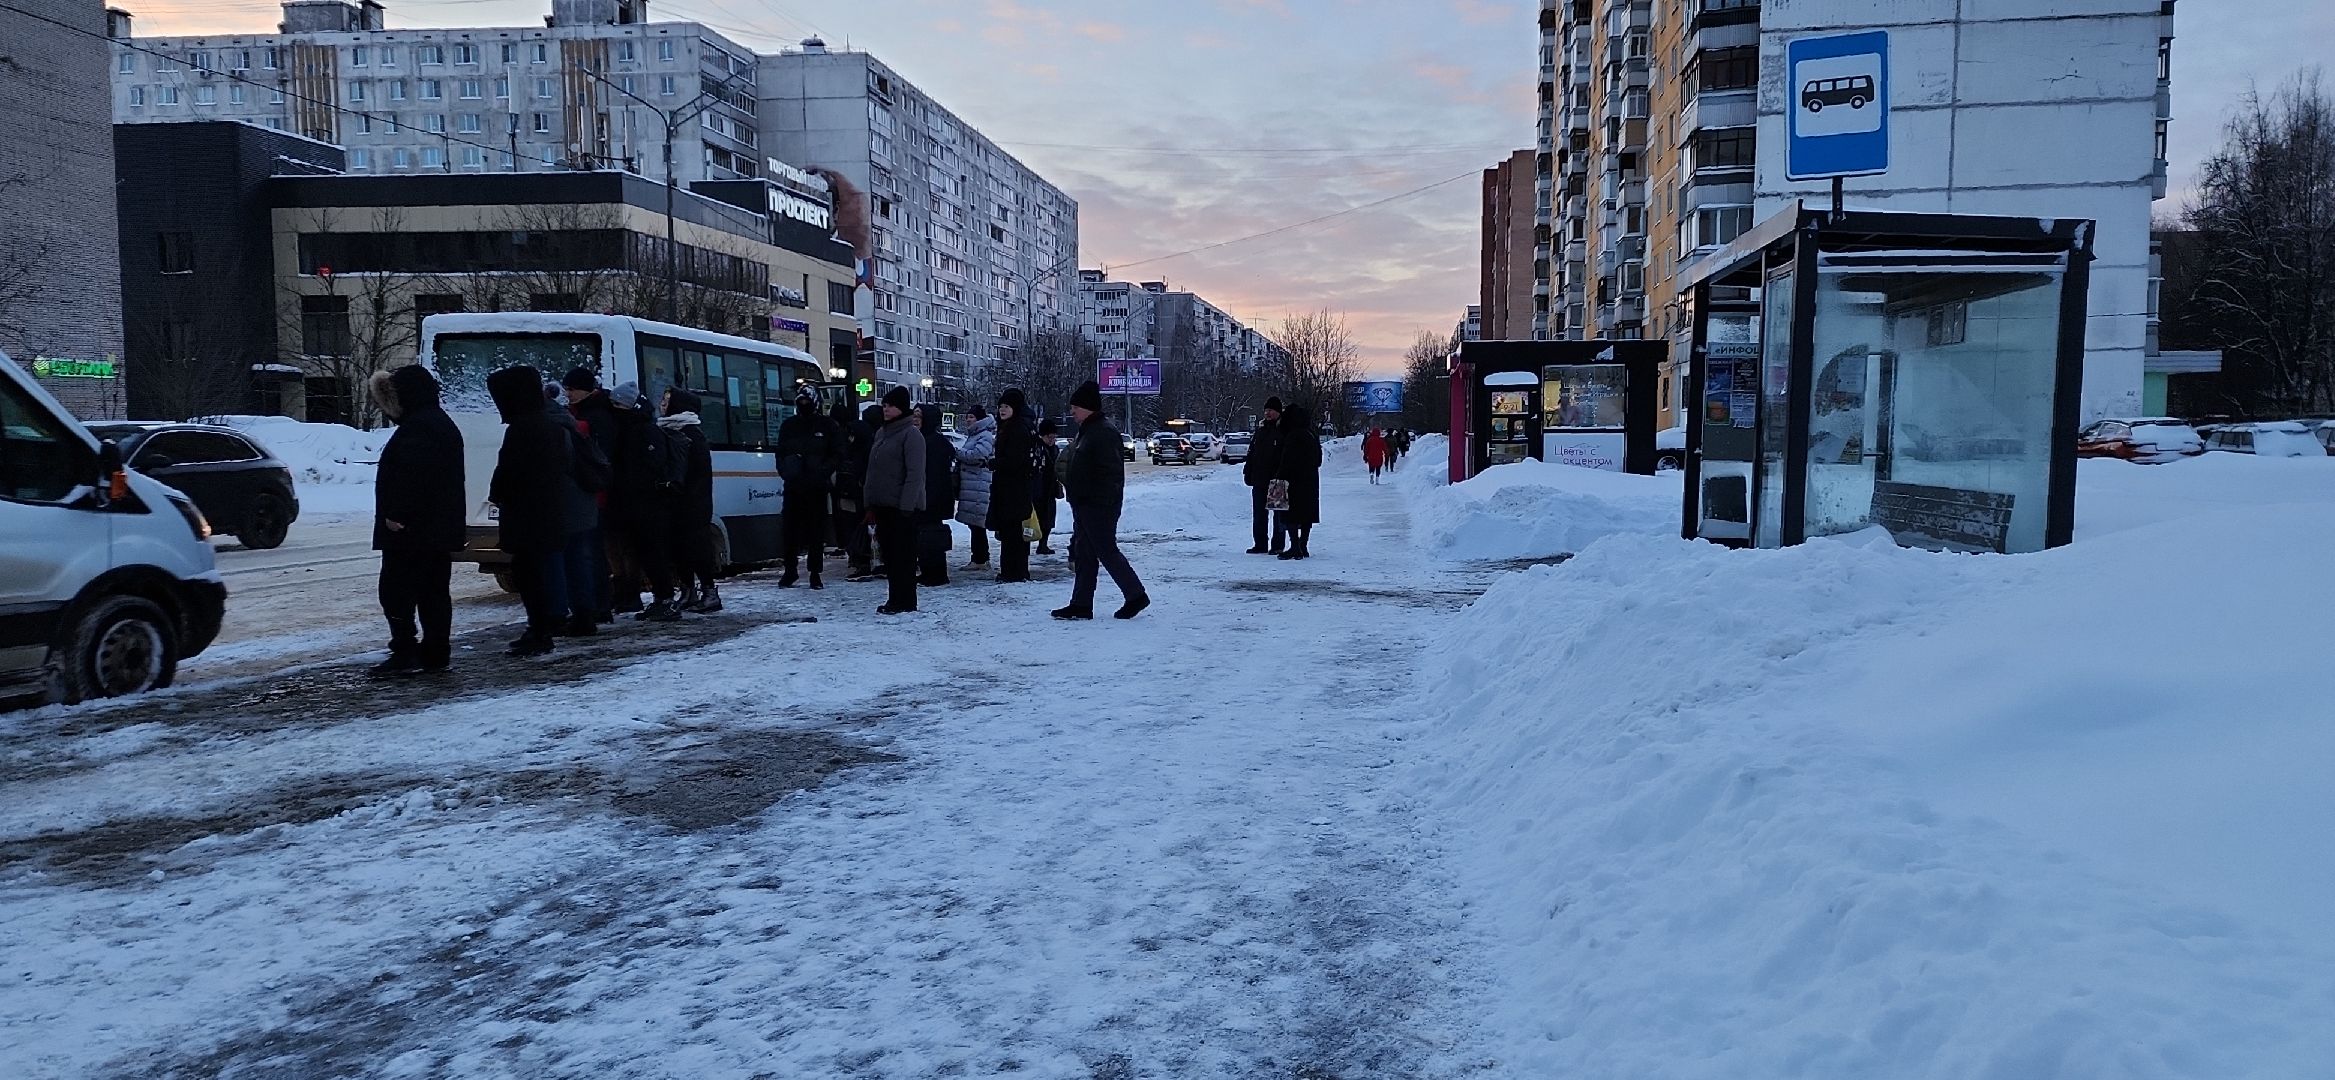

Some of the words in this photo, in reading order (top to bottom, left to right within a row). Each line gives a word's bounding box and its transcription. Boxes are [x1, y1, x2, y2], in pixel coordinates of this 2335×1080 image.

[767, 157, 806, 184] ТОРГОВЫЙ
[768, 188, 829, 229] ПРОСПЕКТ
[1554, 445, 1586, 457] Цветы
[1590, 448, 1596, 456] с
[1563, 458, 1613, 467] акцентом
